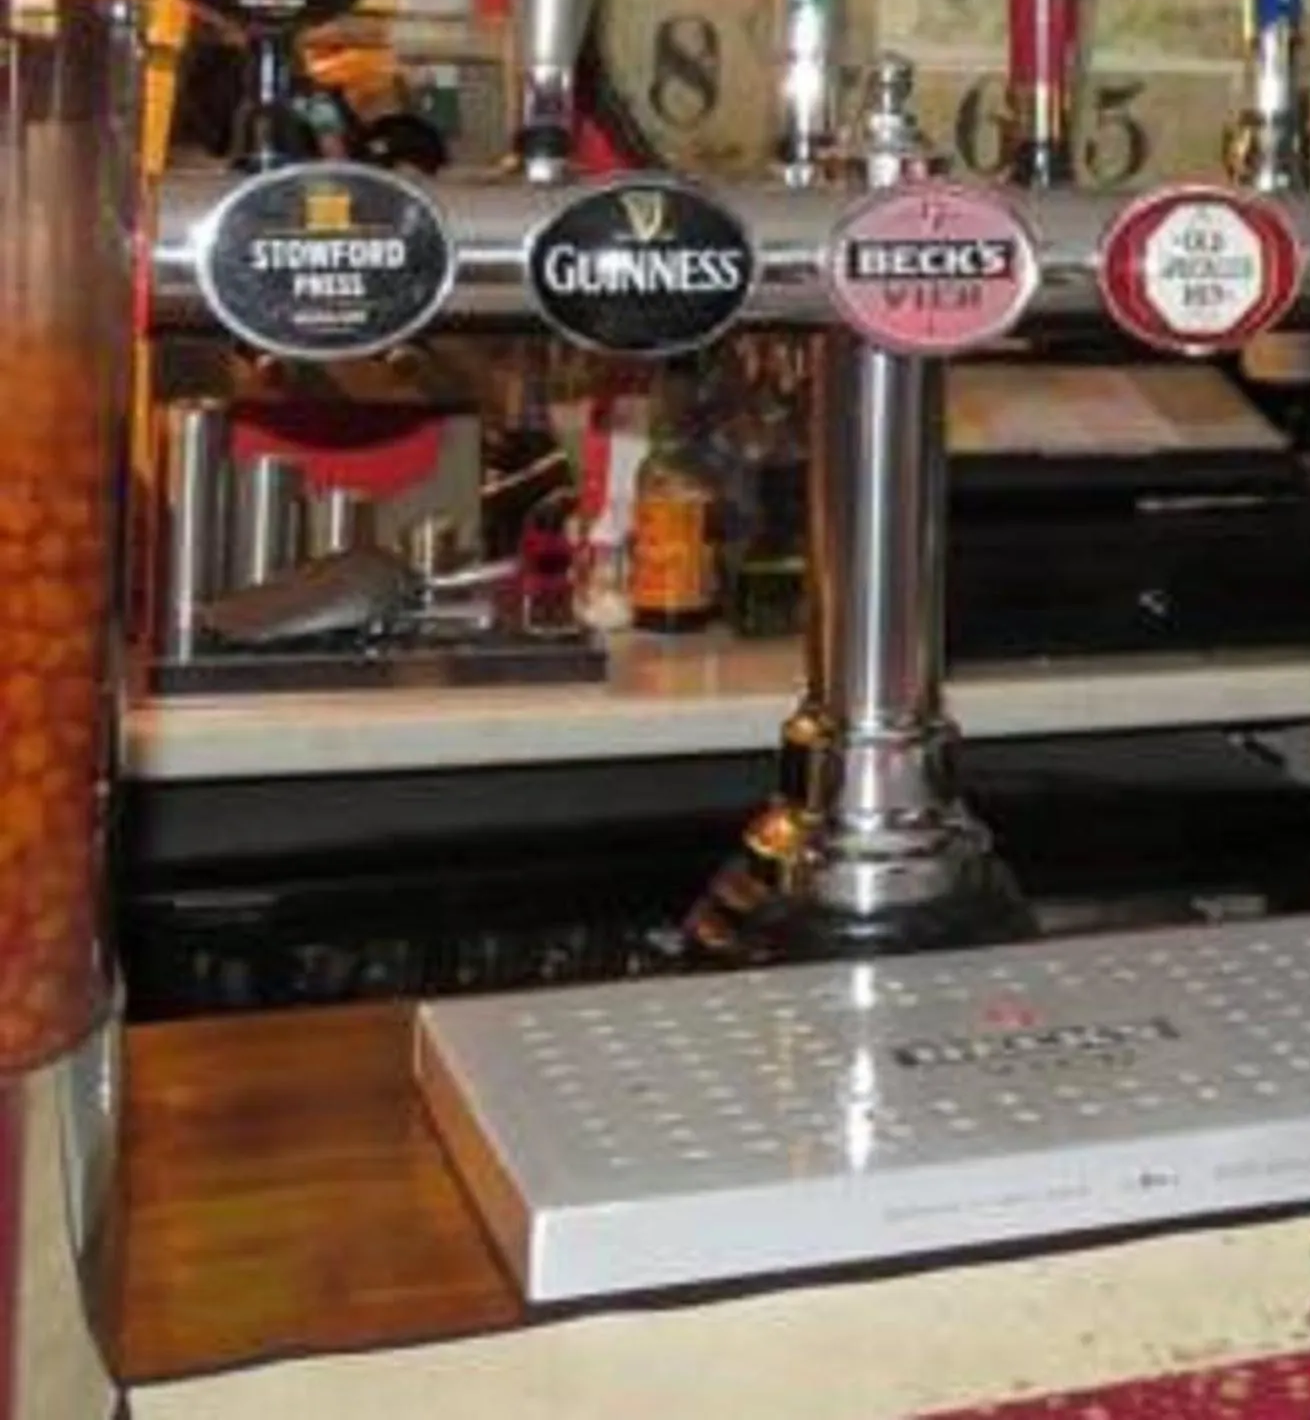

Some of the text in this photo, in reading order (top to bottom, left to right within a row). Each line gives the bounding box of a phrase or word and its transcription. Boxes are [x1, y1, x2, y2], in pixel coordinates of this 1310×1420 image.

[650, 18, 720, 128] 8
[1084, 82, 1150, 179] 5
[250, 237, 406, 272] STOWFORD
[543, 244, 742, 294] GUINNESS
